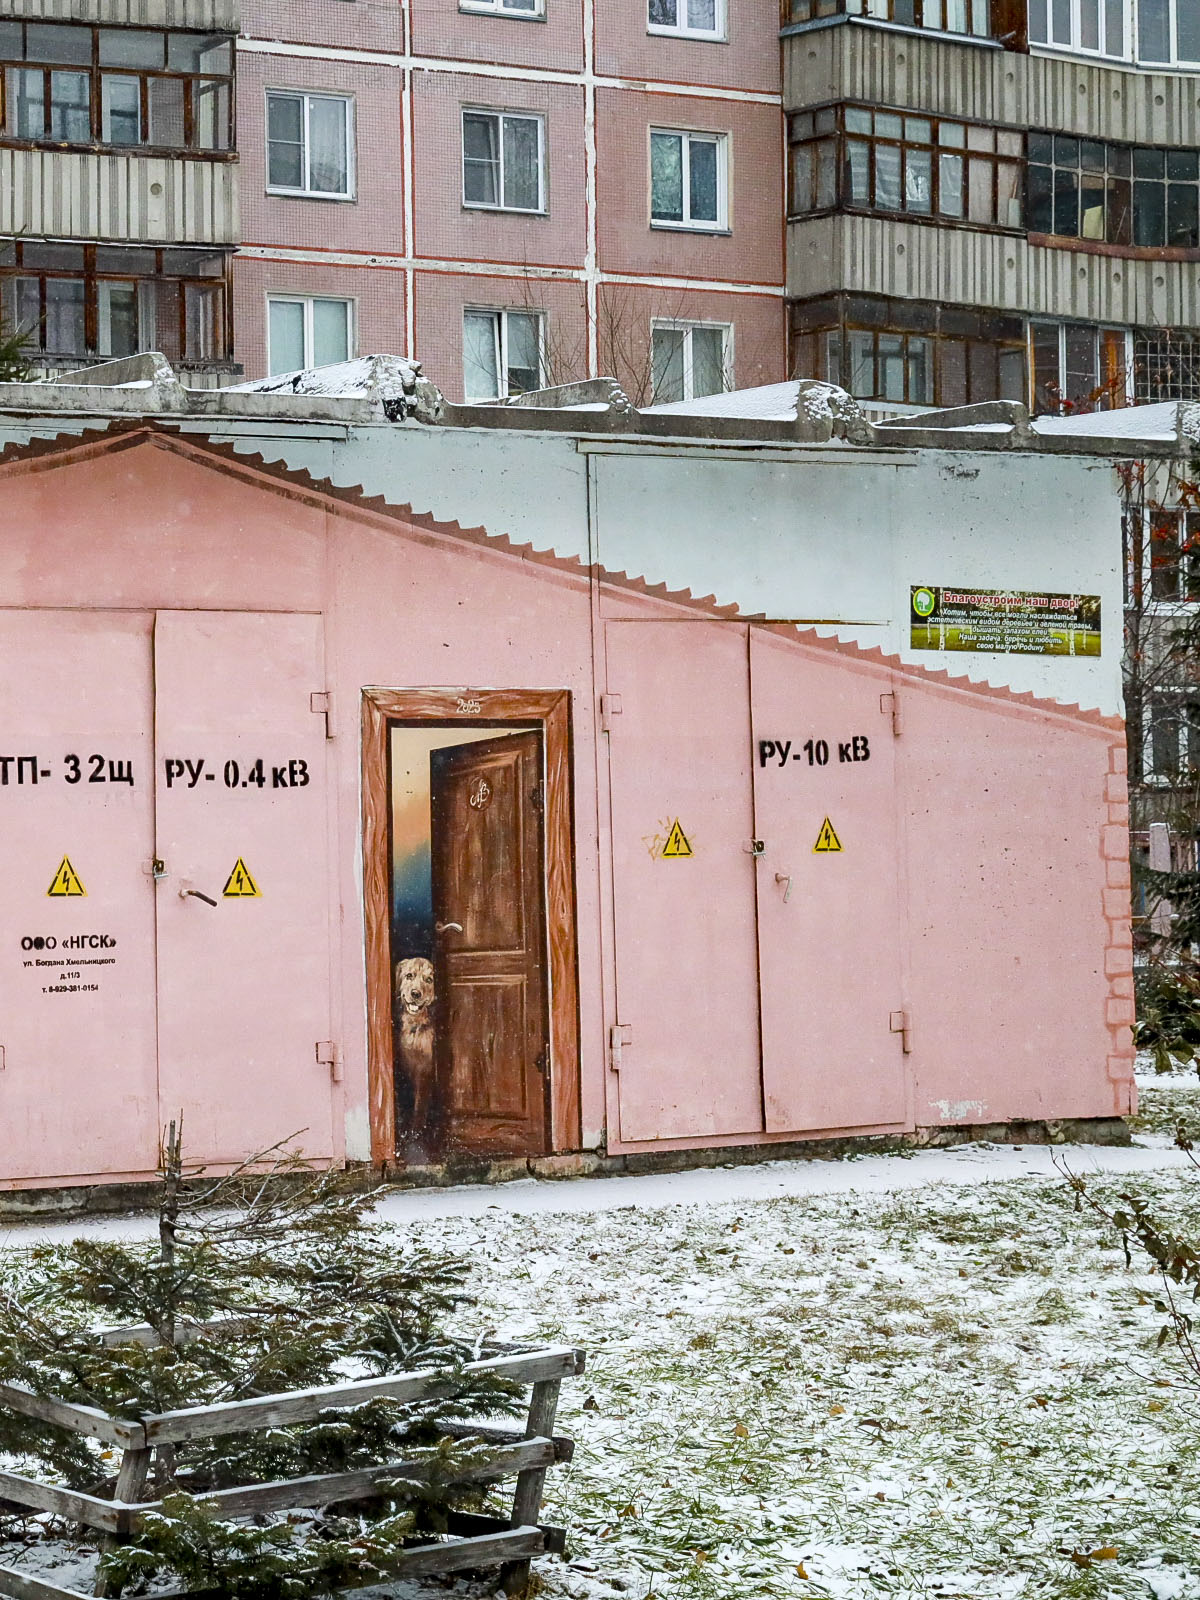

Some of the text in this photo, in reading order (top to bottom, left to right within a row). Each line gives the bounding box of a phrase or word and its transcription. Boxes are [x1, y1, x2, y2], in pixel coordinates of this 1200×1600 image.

[943, 592, 1079, 610] Благоустроим наш двор!
[943, 608, 967, 617] Хотим,
[1029, 612, 1078, 621] наслаждаться
[927, 616, 978, 625] эстетическим
[1002, 618, 1032, 627] деревьев
[1005, 634, 1028, 643] беречь
[1035, 636, 1062, 644] любить
[995, 643, 1018, 651] малую
[1019, 643, 1045, 652] Родину.
[758, 735, 871, 768] РУ-10 кВ
[165, 758, 310, 788] РУ- 0.4 кВ
[21, 934, 117, 950] ООО «НГСК»
[23, 957, 116, 968] ул. Богдана Хмельницкого
[59, 971, 81, 980] д.11/3
